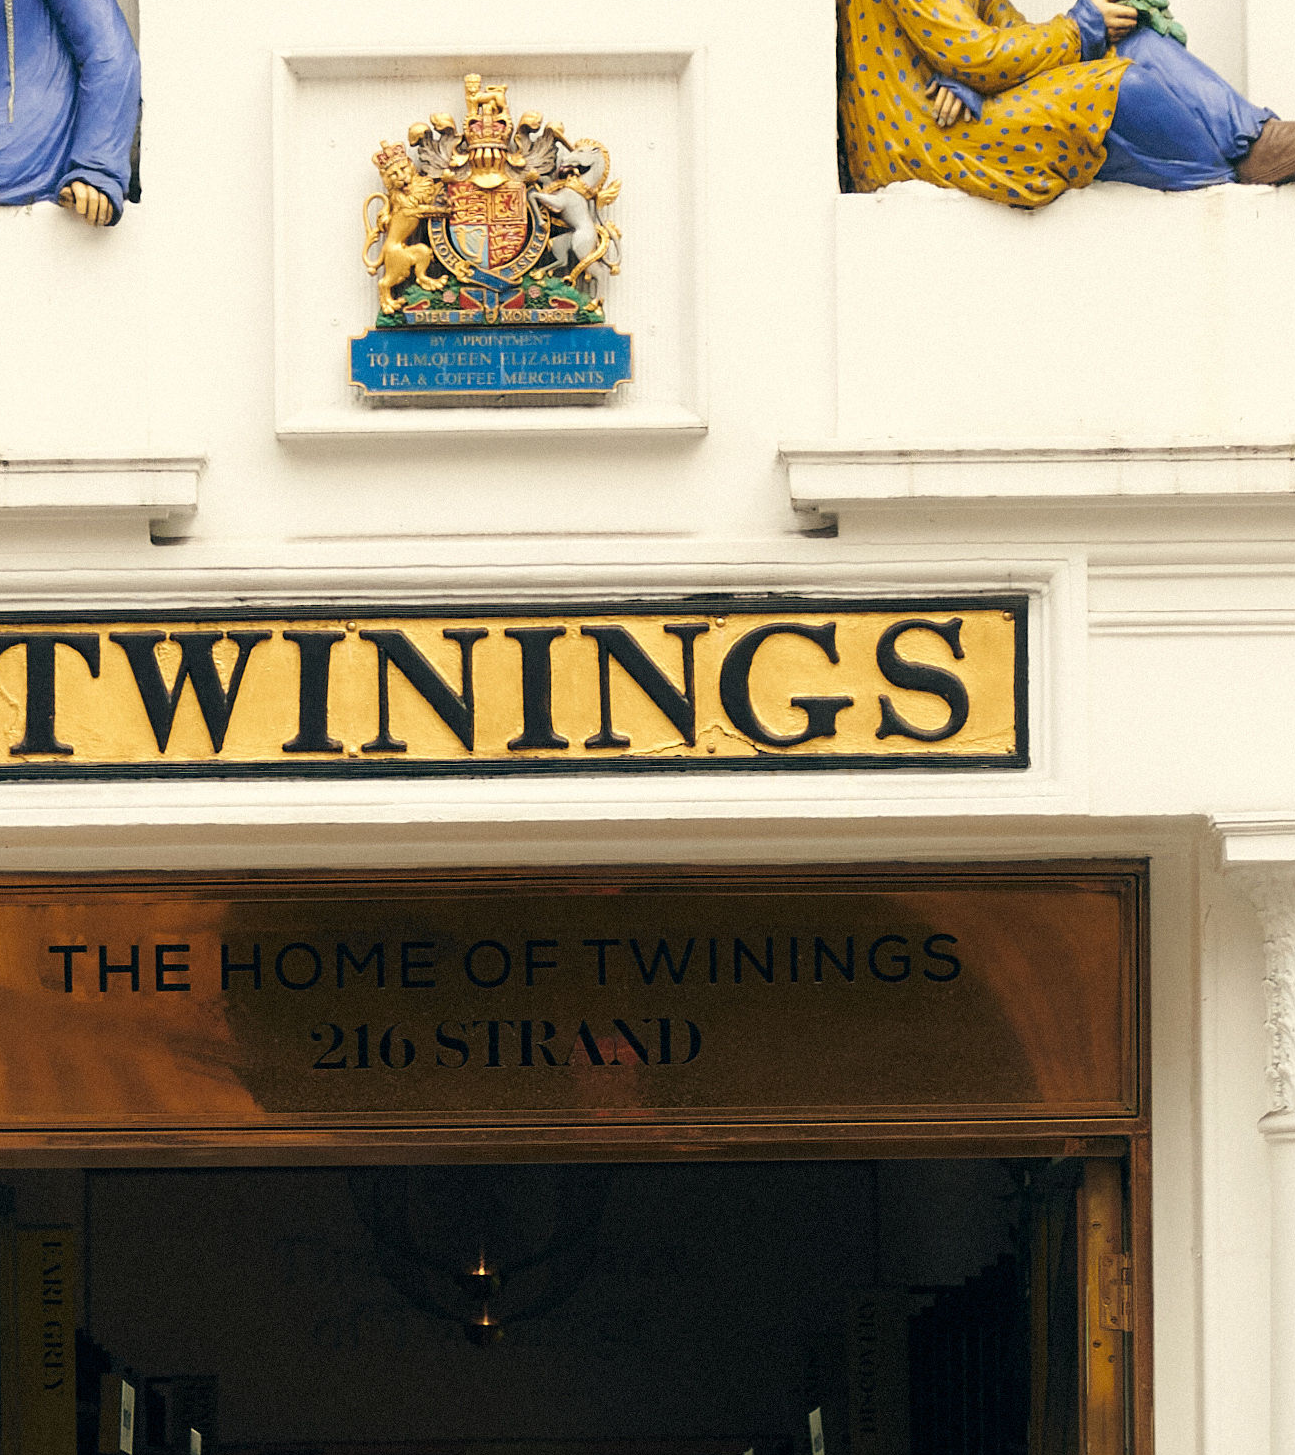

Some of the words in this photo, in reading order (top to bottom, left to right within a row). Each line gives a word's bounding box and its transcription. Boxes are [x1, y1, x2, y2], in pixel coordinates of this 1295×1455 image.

[501, 310, 532, 322] MON
[538, 310, 575, 322] DROIT
[430, 336, 446, 347] BY
[452, 334, 552, 347] APPOINTMENT
[367, 353, 389, 367] TO
[500, 351, 596, 366] ELIZABETH
[604, 351, 616, 364] II
[380, 373, 410, 387] TEA
[417, 373, 427, 386] &
[435, 372, 496, 386] COFFEE
[504, 370, 605, 385] MERCHANTS
[49, 943, 192, 994] THE
[220, 940, 437, 992] HOME
[463, 938, 559, 989] OF
[583, 932, 963, 987] TWININGS
[310, 1020, 415, 1072] 216
[435, 1015, 703, 1069] STRAND
